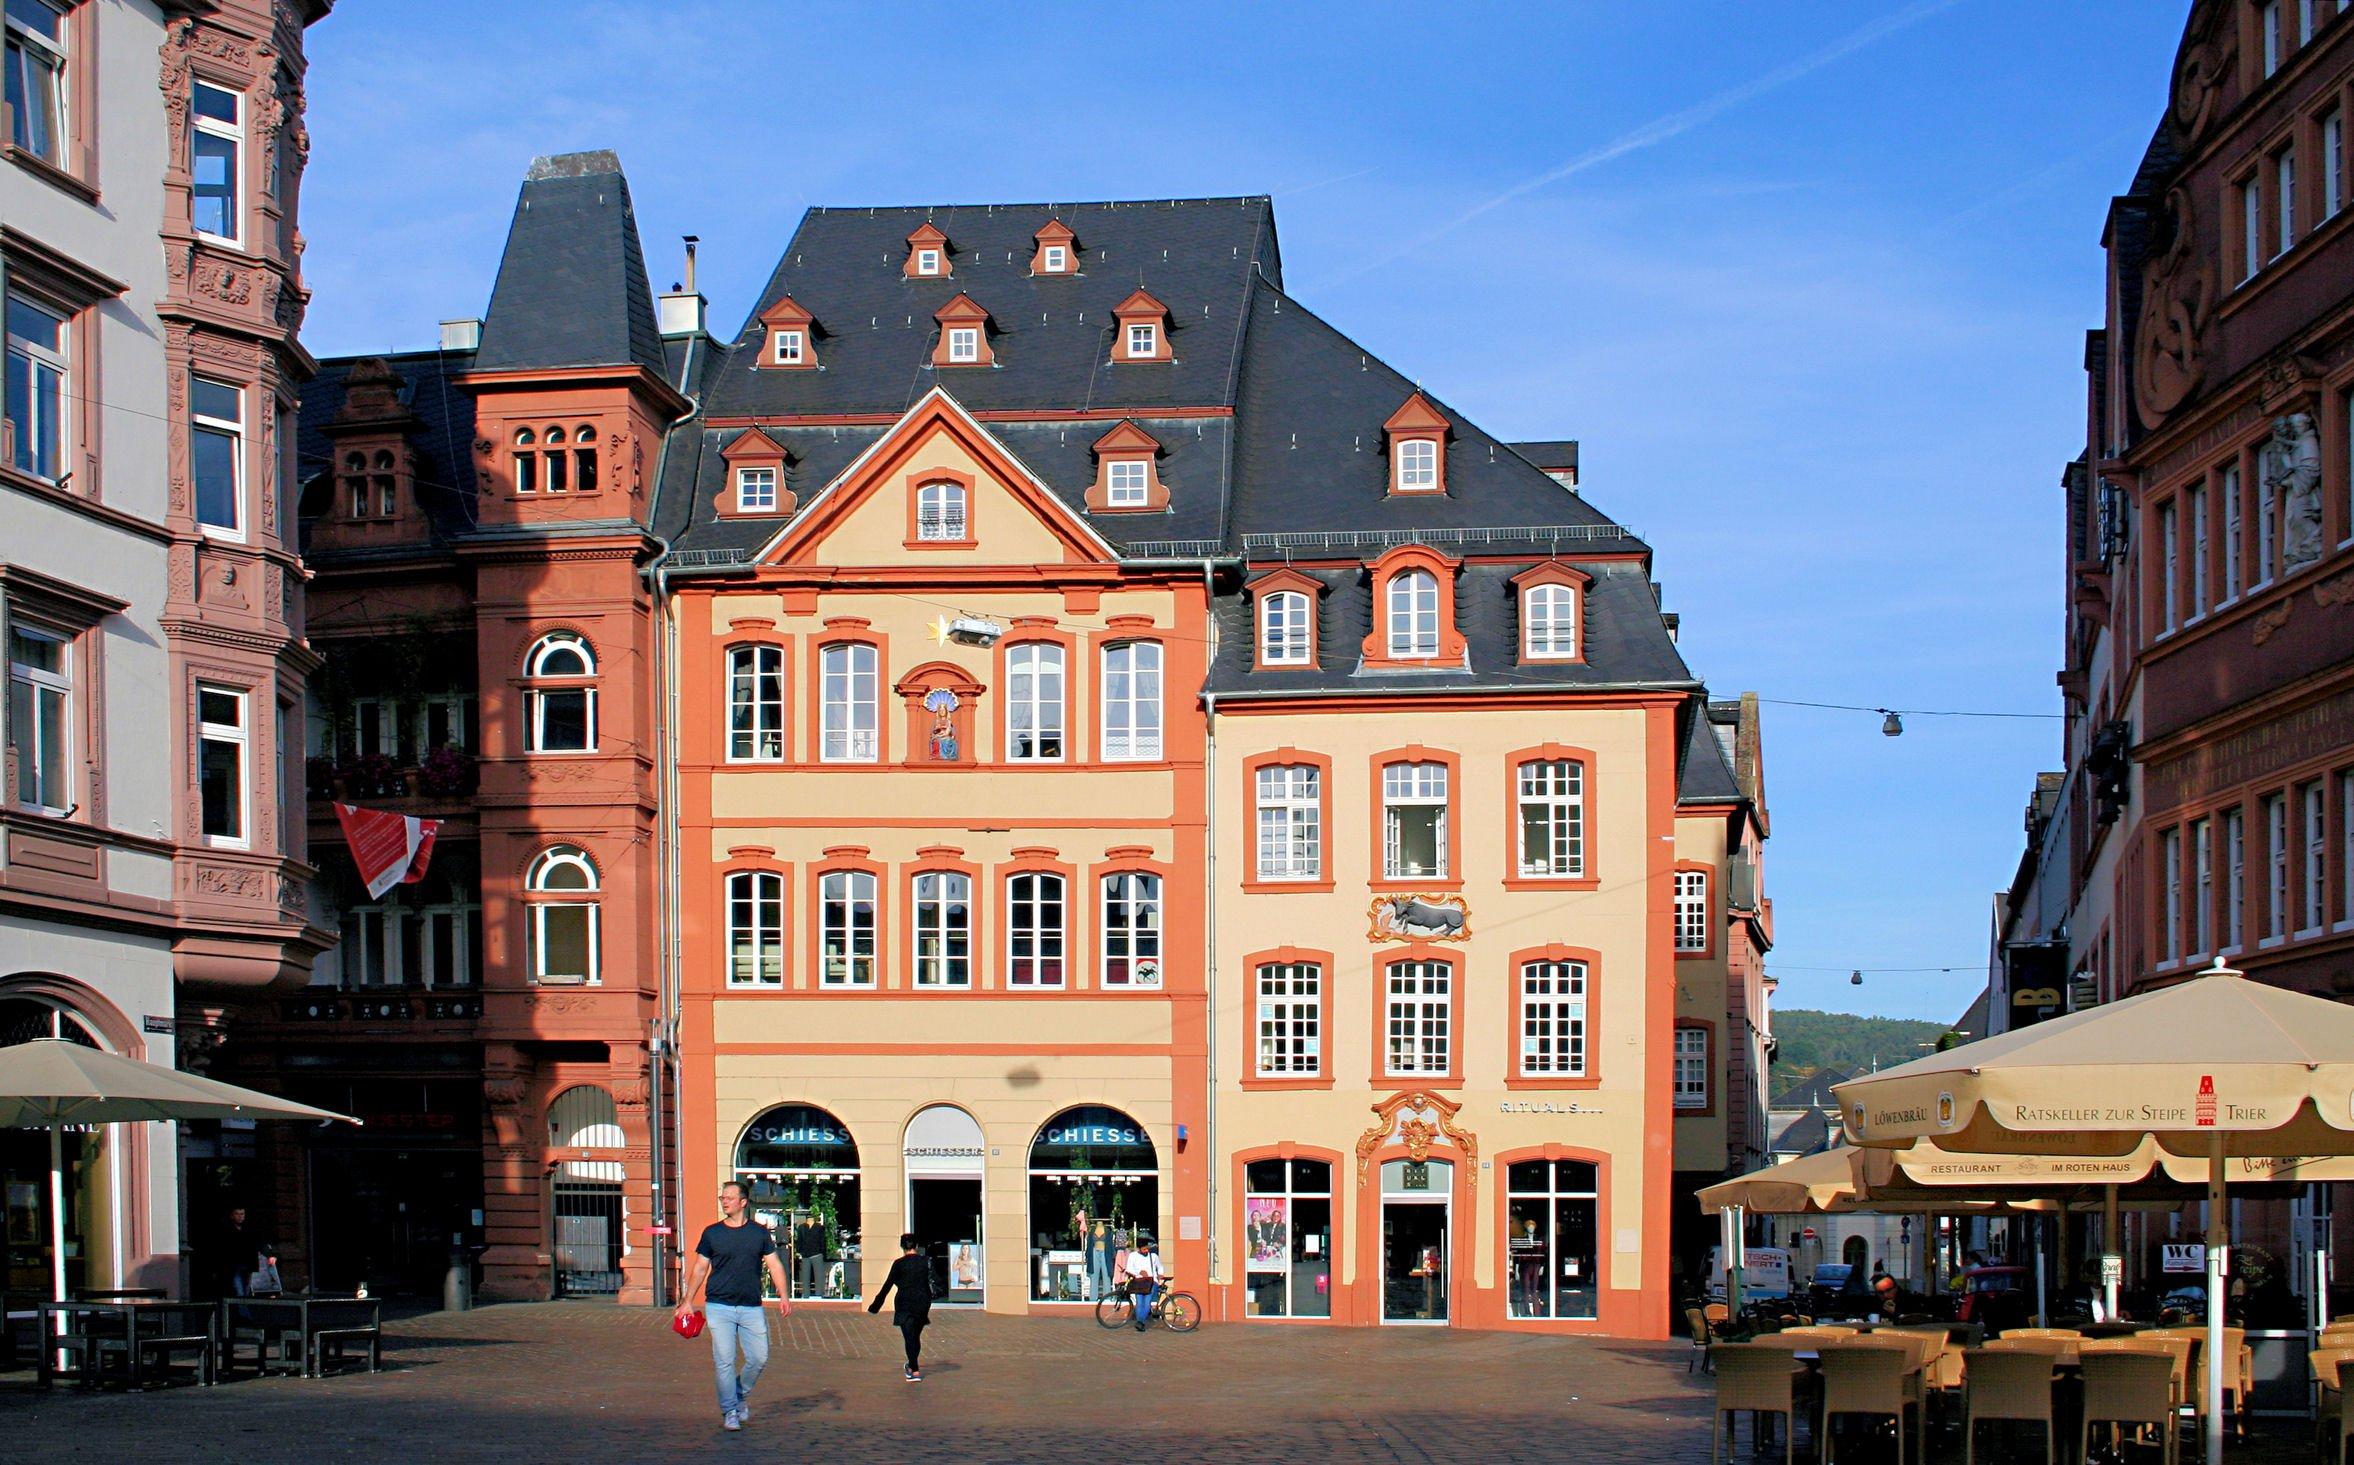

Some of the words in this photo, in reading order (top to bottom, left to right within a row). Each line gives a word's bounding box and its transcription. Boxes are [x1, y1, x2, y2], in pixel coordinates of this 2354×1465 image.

[1874, 1106, 1929, 1126] LÖWENBRÄU
[2141, 1104, 2187, 1120] STEIPE
[2225, 1104, 2267, 1120] TRIER
[908, 1147, 982, 1157] SCHIESSER
[1931, 1164, 2002, 1173] RESTAURANT
[2051, 1164, 2063, 1172] IM
[2065, 1163, 2099, 1172] ROTEN
[2102, 1163, 2132, 1172] HAUS
[2167, 1245, 2199, 1259] WC
